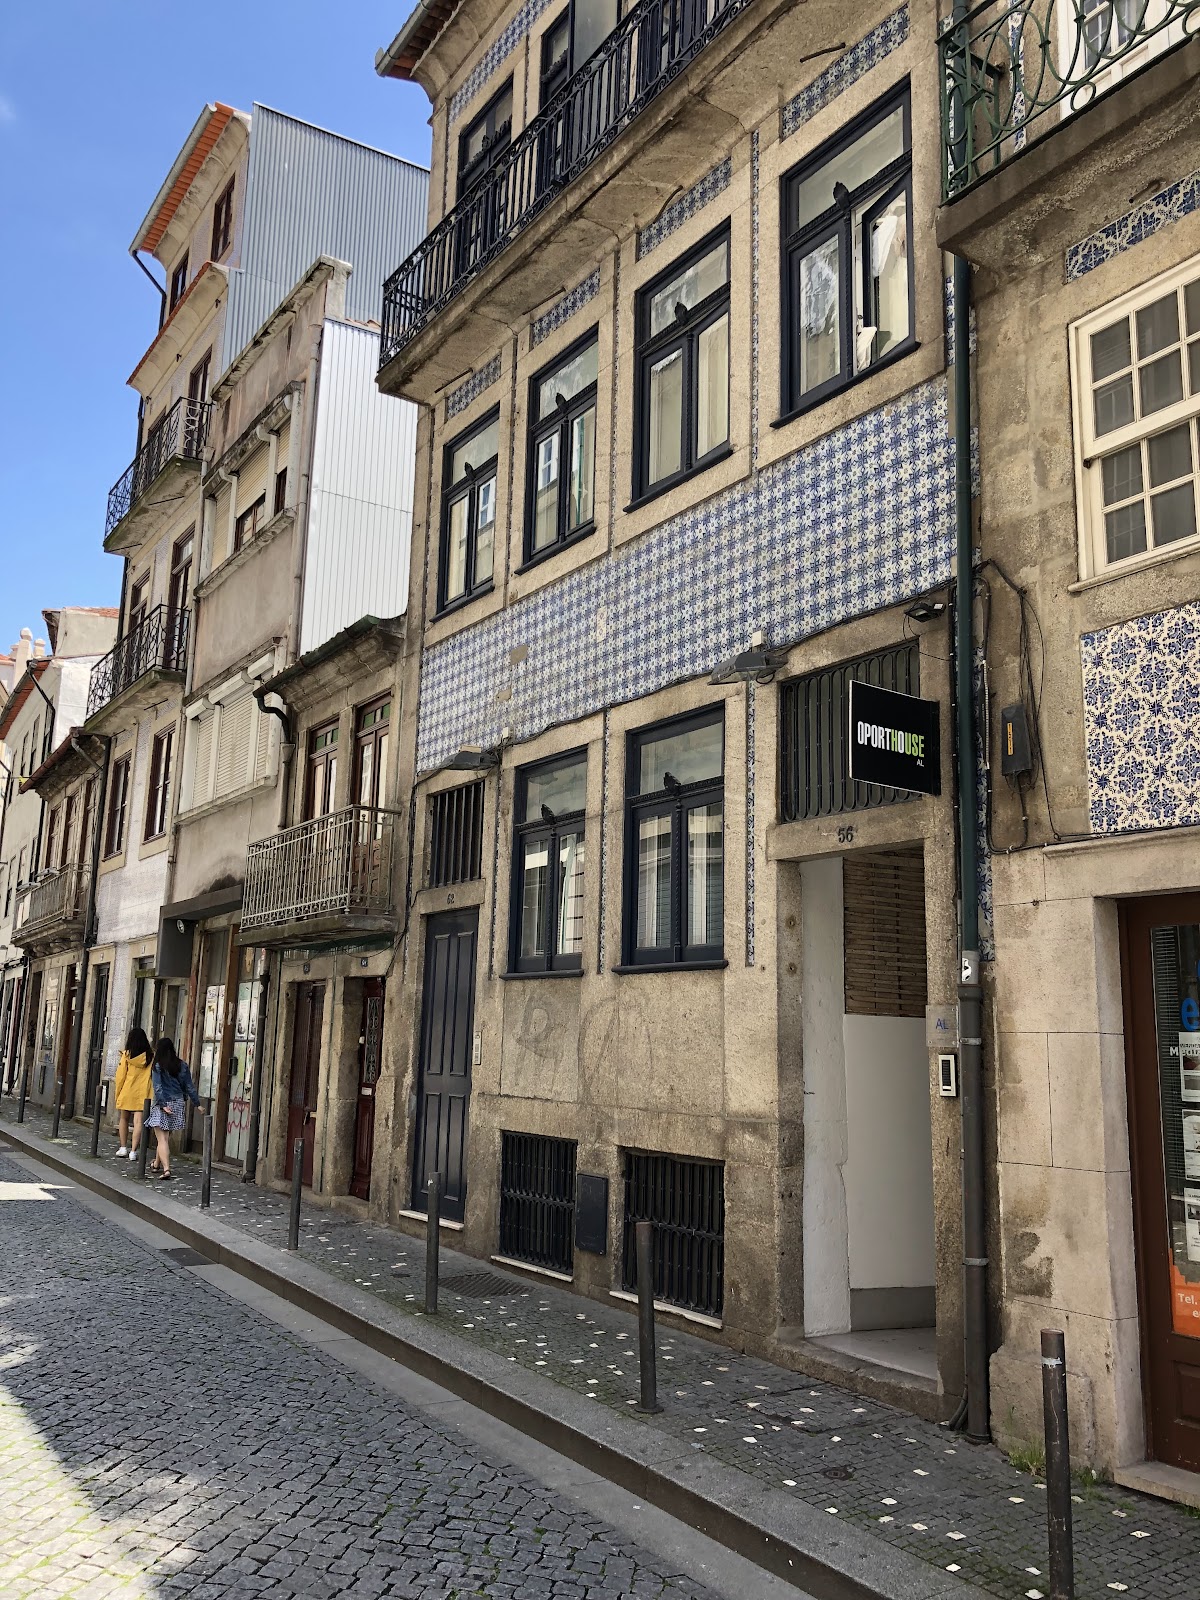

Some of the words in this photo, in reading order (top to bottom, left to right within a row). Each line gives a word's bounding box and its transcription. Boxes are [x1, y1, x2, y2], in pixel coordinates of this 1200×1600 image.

[857, 720, 925, 758] OPORTHOUSE
[916, 758, 925, 767] AL
[837, 825, 854, 843] 56
[935, 1017, 949, 1030] AL
[1178, 1292, 1198, 1305] Tel.
[1192, 1308, 1200, 1319] e
